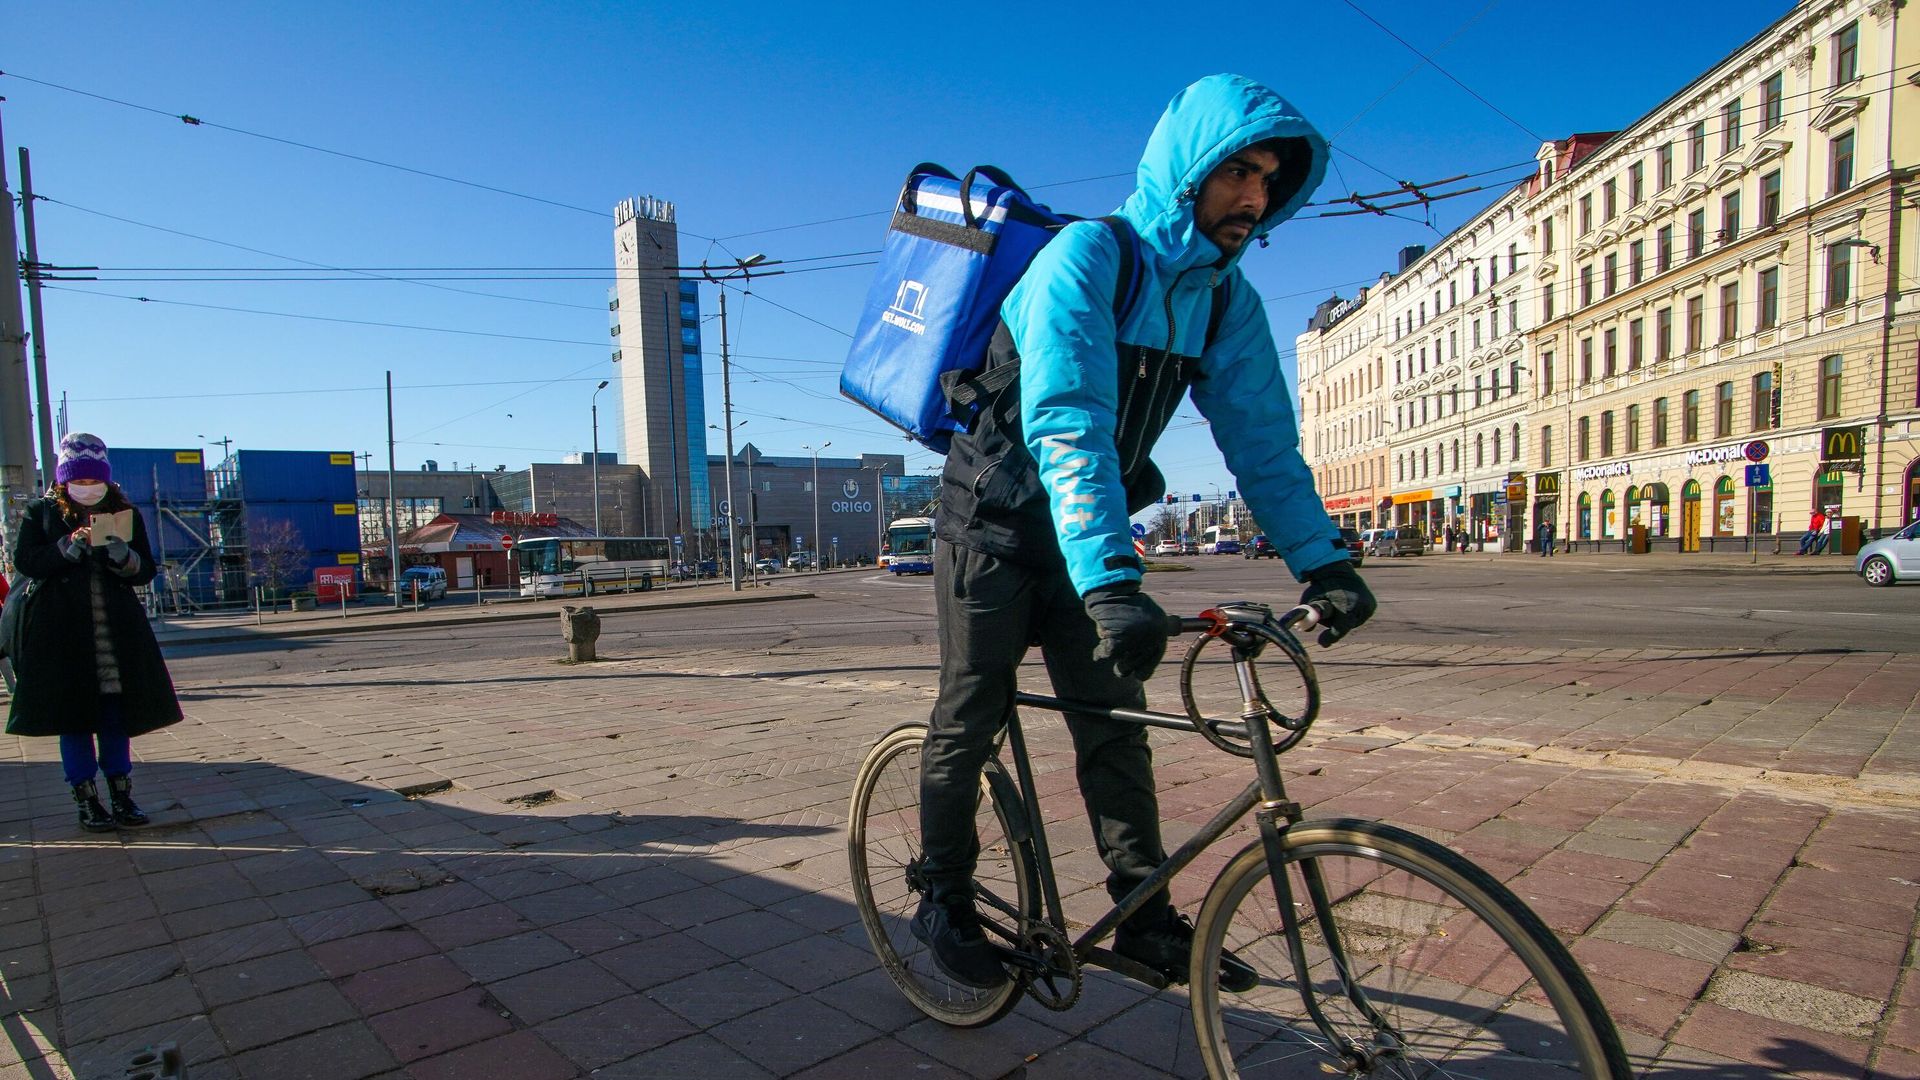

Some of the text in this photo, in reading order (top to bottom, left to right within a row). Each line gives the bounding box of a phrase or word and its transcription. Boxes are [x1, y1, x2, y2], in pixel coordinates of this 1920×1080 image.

[1041, 431, 1096, 536] Wolt
[831, 501, 872, 513] ORIGO
[711, 516, 743, 526] ORIO
